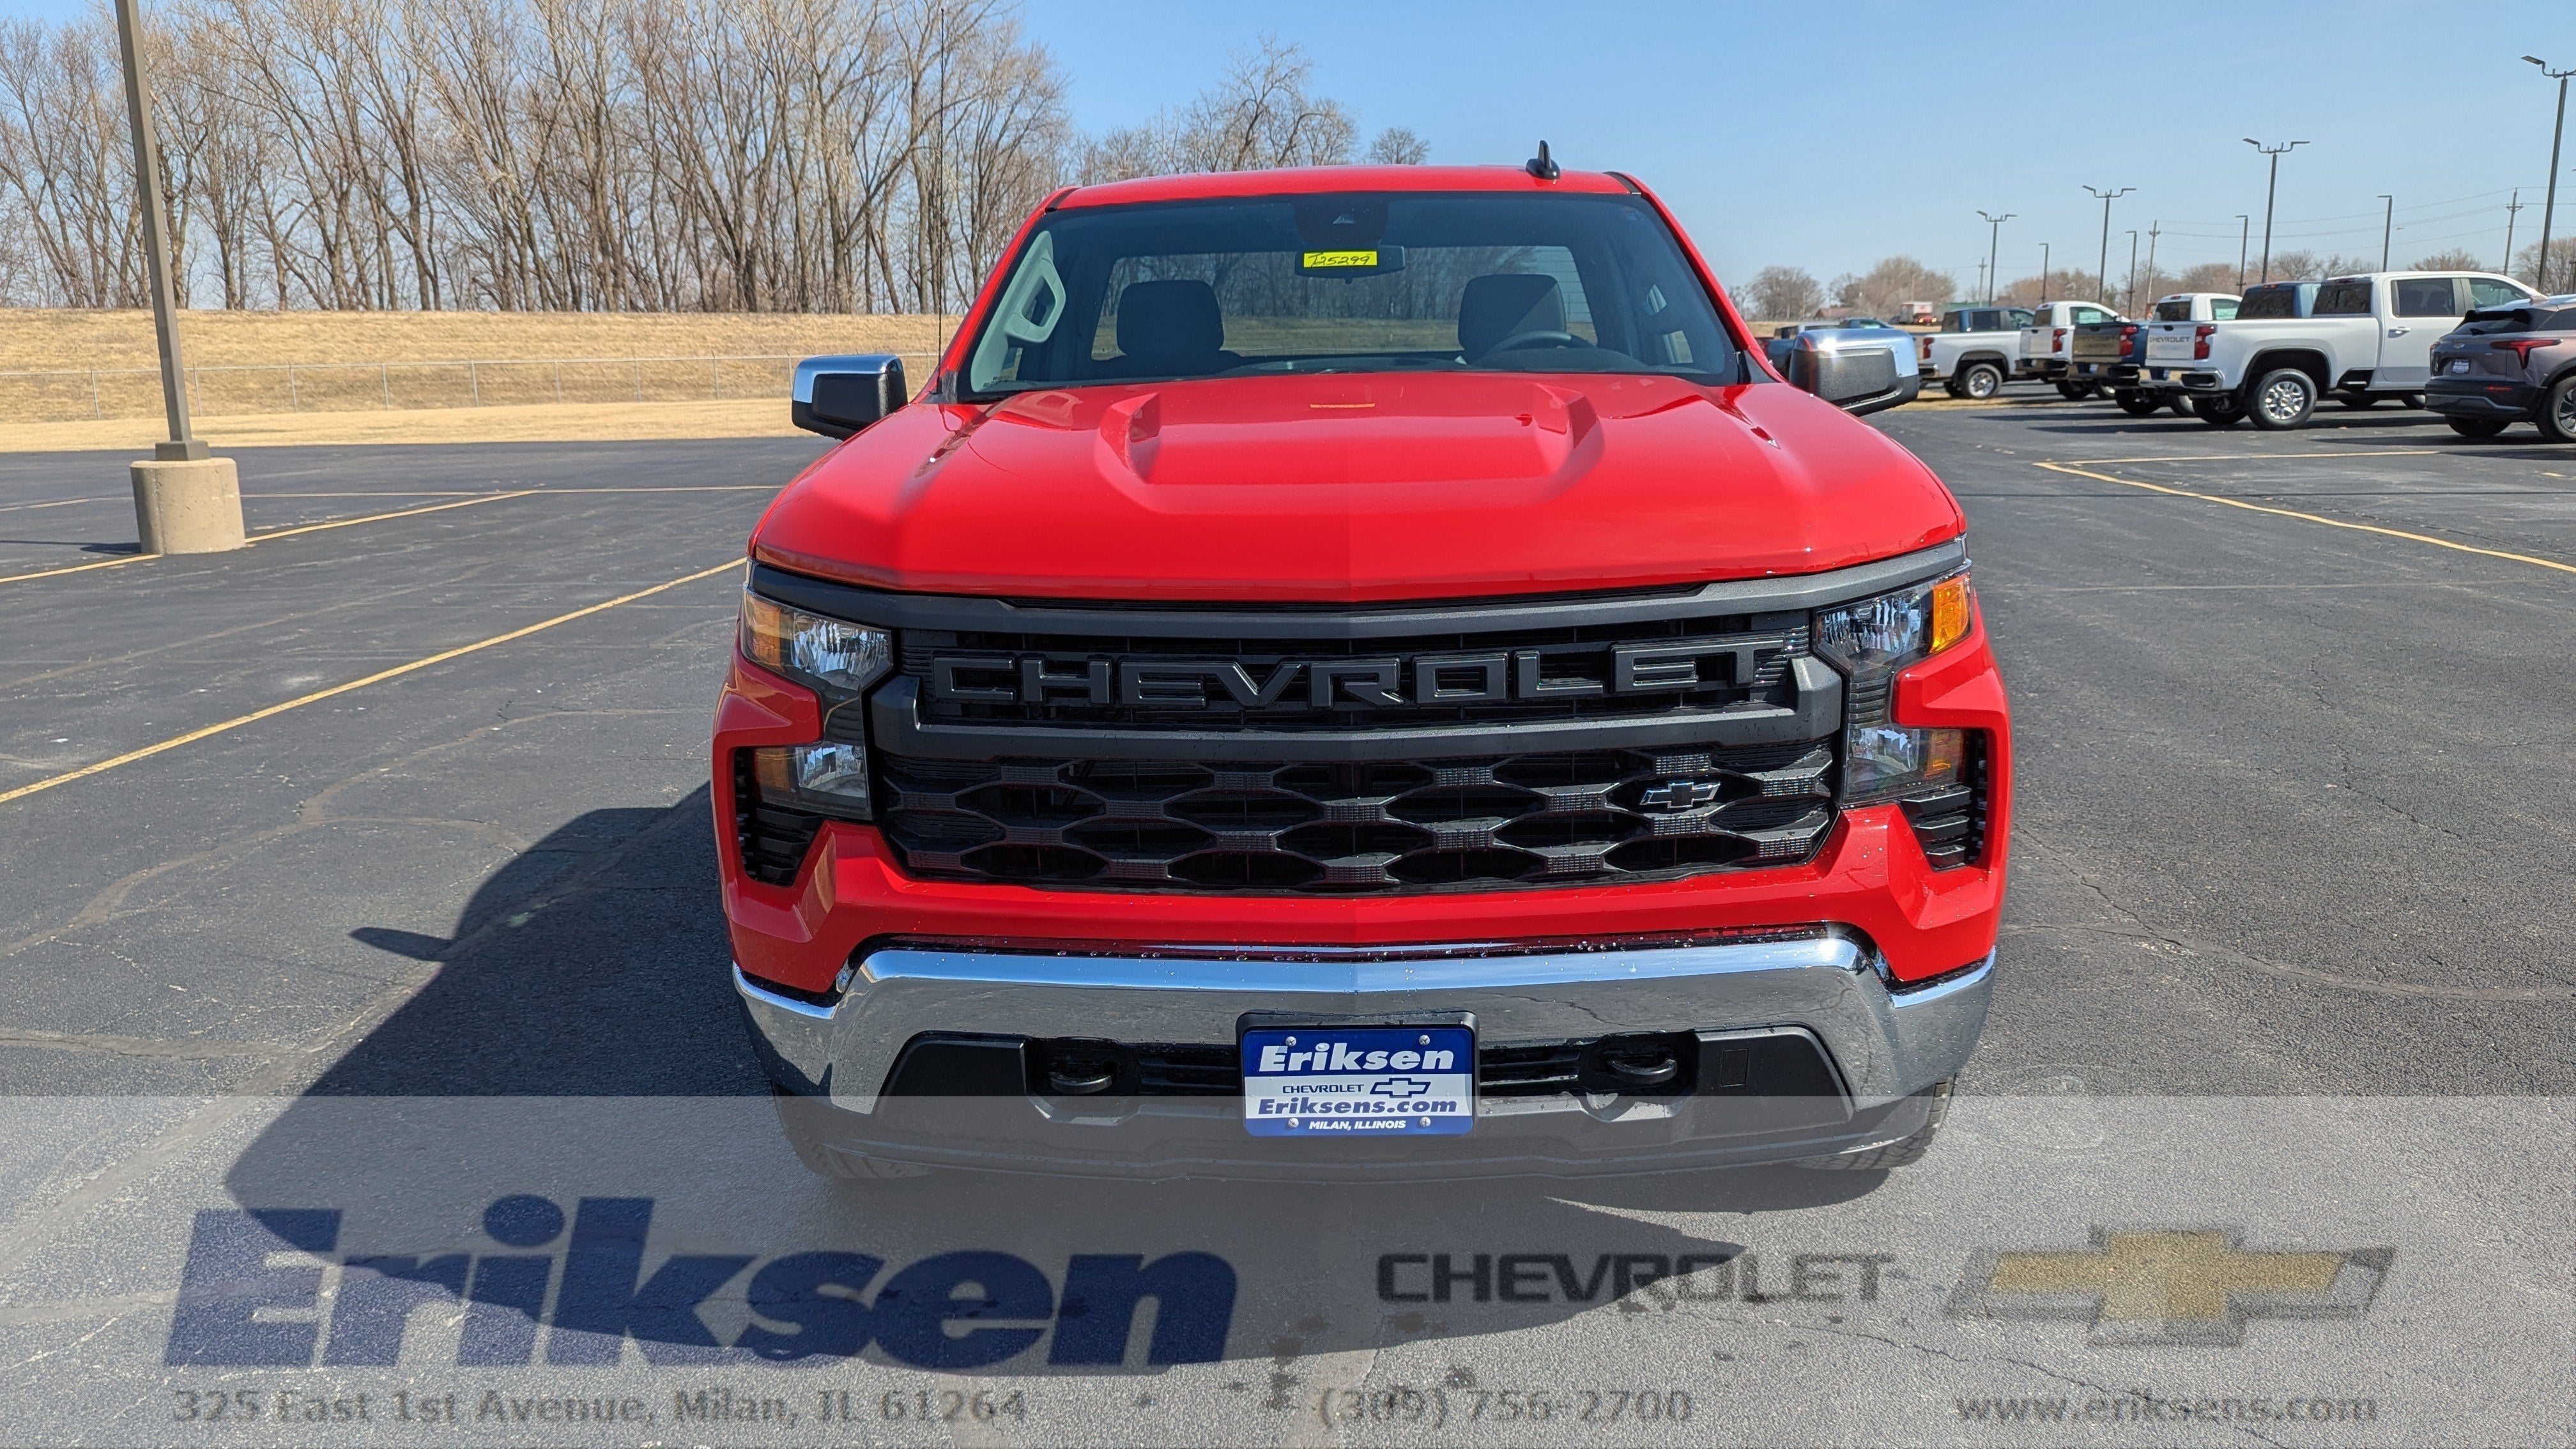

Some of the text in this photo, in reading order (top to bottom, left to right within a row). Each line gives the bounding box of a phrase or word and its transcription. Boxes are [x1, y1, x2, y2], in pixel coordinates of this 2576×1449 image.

[933, 638, 1785, 708] CHEVROLET
[1259, 1043, 1454, 1072] Eriksen
[1282, 1084, 1364, 1094] CHEVROLET
[1258, 1096, 1457, 1115] Eriksens.com
[1309, 1120, 1407, 1131] MILAN, ILLINOIS
